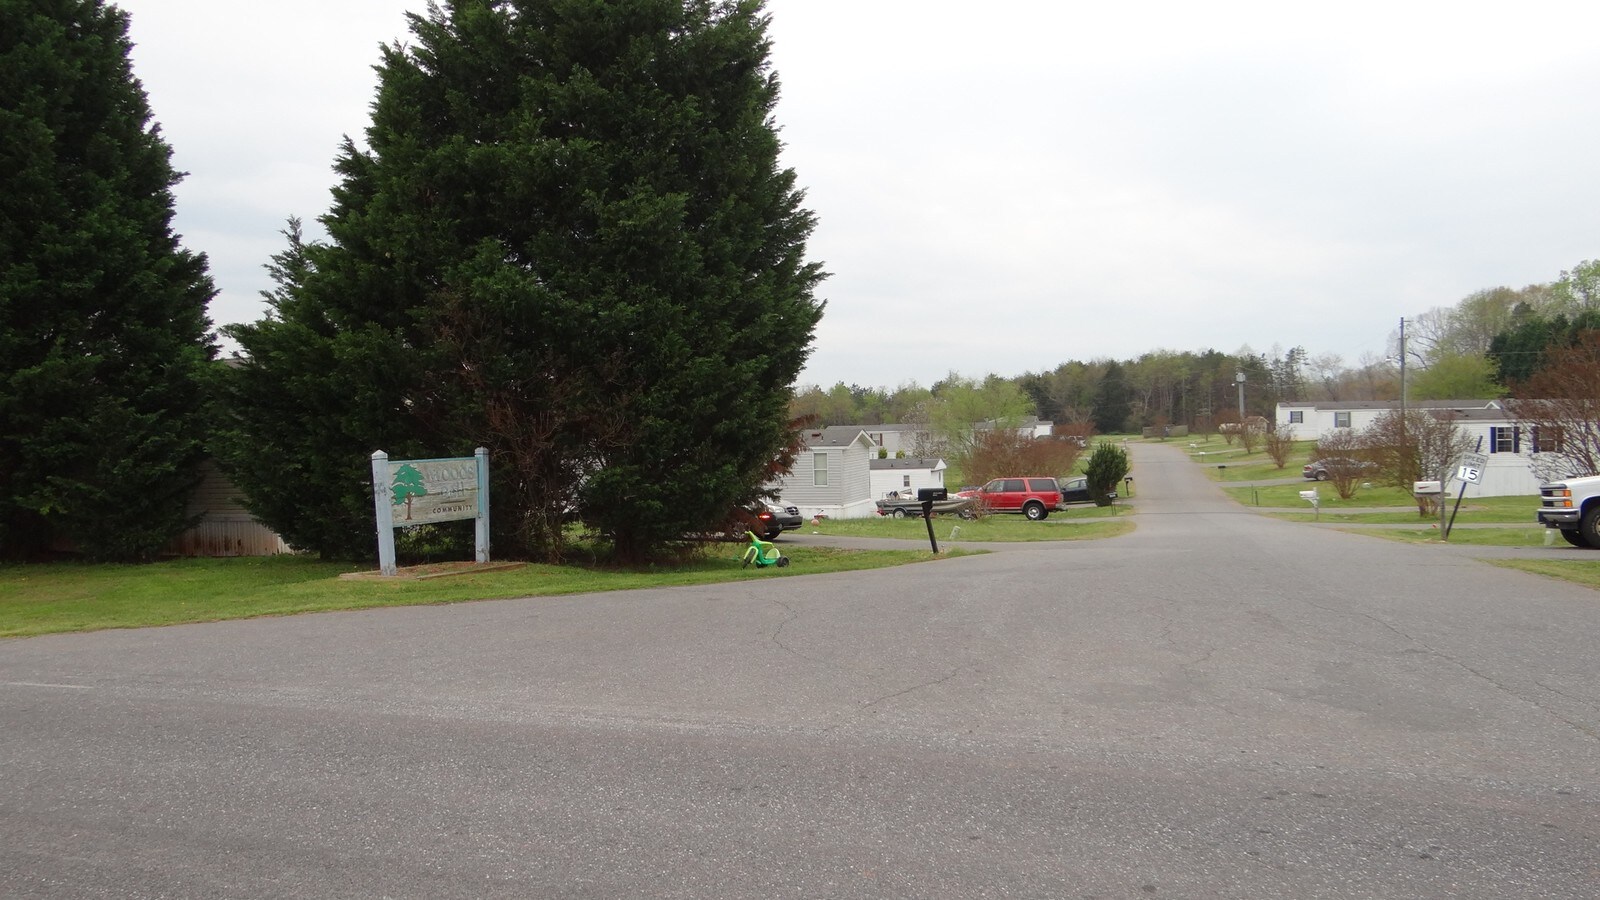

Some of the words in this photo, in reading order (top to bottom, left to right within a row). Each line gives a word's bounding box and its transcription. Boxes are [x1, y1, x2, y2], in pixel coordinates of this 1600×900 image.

[1463, 454, 1485, 464] SPEED
[1463, 461, 1481, 469] LIMIT
[1462, 467, 1478, 480] 15
[432, 504, 473, 514] COMMUNITY
